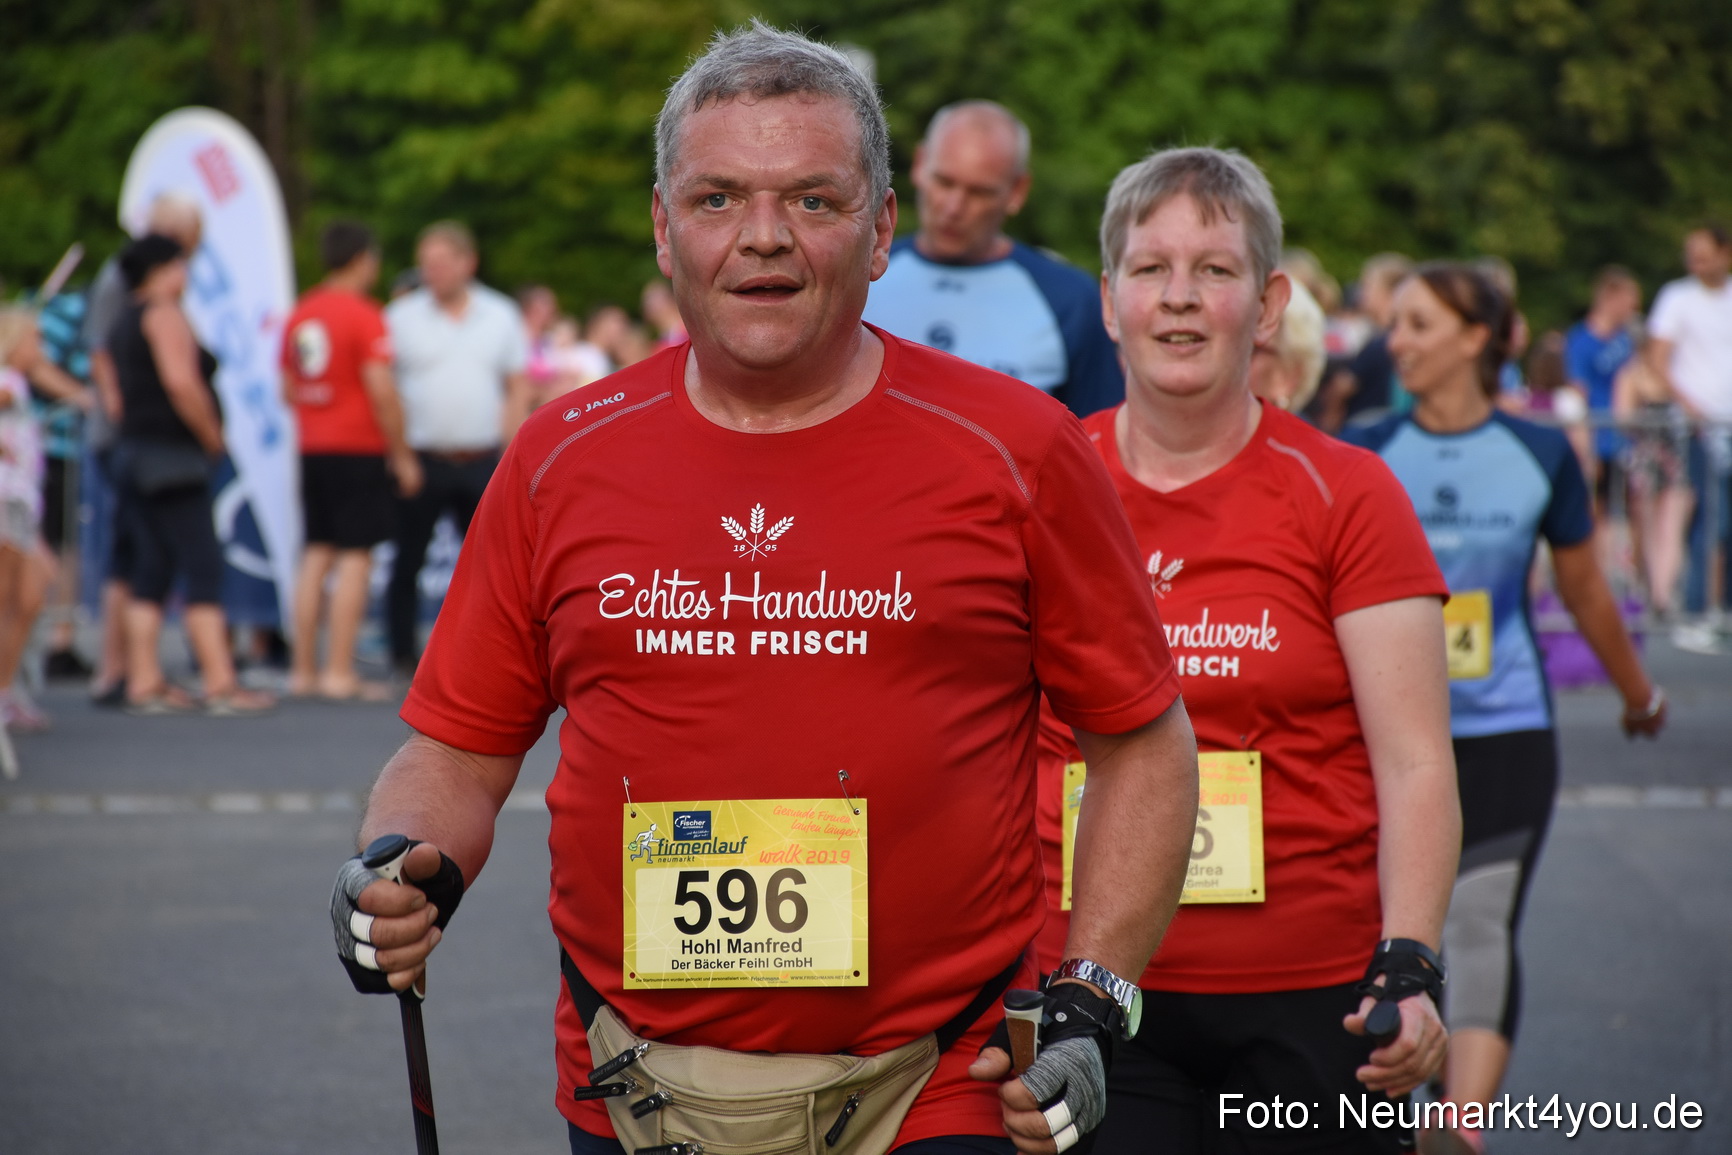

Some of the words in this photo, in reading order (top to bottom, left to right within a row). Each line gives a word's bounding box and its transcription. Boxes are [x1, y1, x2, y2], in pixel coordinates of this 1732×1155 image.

[585, 392, 625, 412] JAKO
[733, 544, 746, 552] 18
[764, 544, 777, 552] 95
[598, 569, 715, 619] Echtes
[720, 570, 916, 622] Handwerk
[1163, 608, 1281, 652] andwerk
[635, 629, 735, 655] IMMER
[750, 630, 868, 655] FRISCH
[1178, 655, 1240, 677] ISCH
[680, 819, 706, 827] Fischer
[773, 805, 815, 820] Gesunde
[818, 811, 851, 824] Firmen
[658, 836, 748, 856] firmenlauf
[760, 844, 802, 864] walk
[806, 850, 851, 864] 2019
[1190, 865, 1223, 876] drea
[673, 868, 809, 935] 596
[681, 939, 721, 955] Hohl
[727, 938, 803, 954] Manfred
[671, 959, 691, 970] Der
[694, 958, 735, 970] Bäcker
[739, 957, 769, 969] Feihl
[773, 957, 813, 969] GmbH
